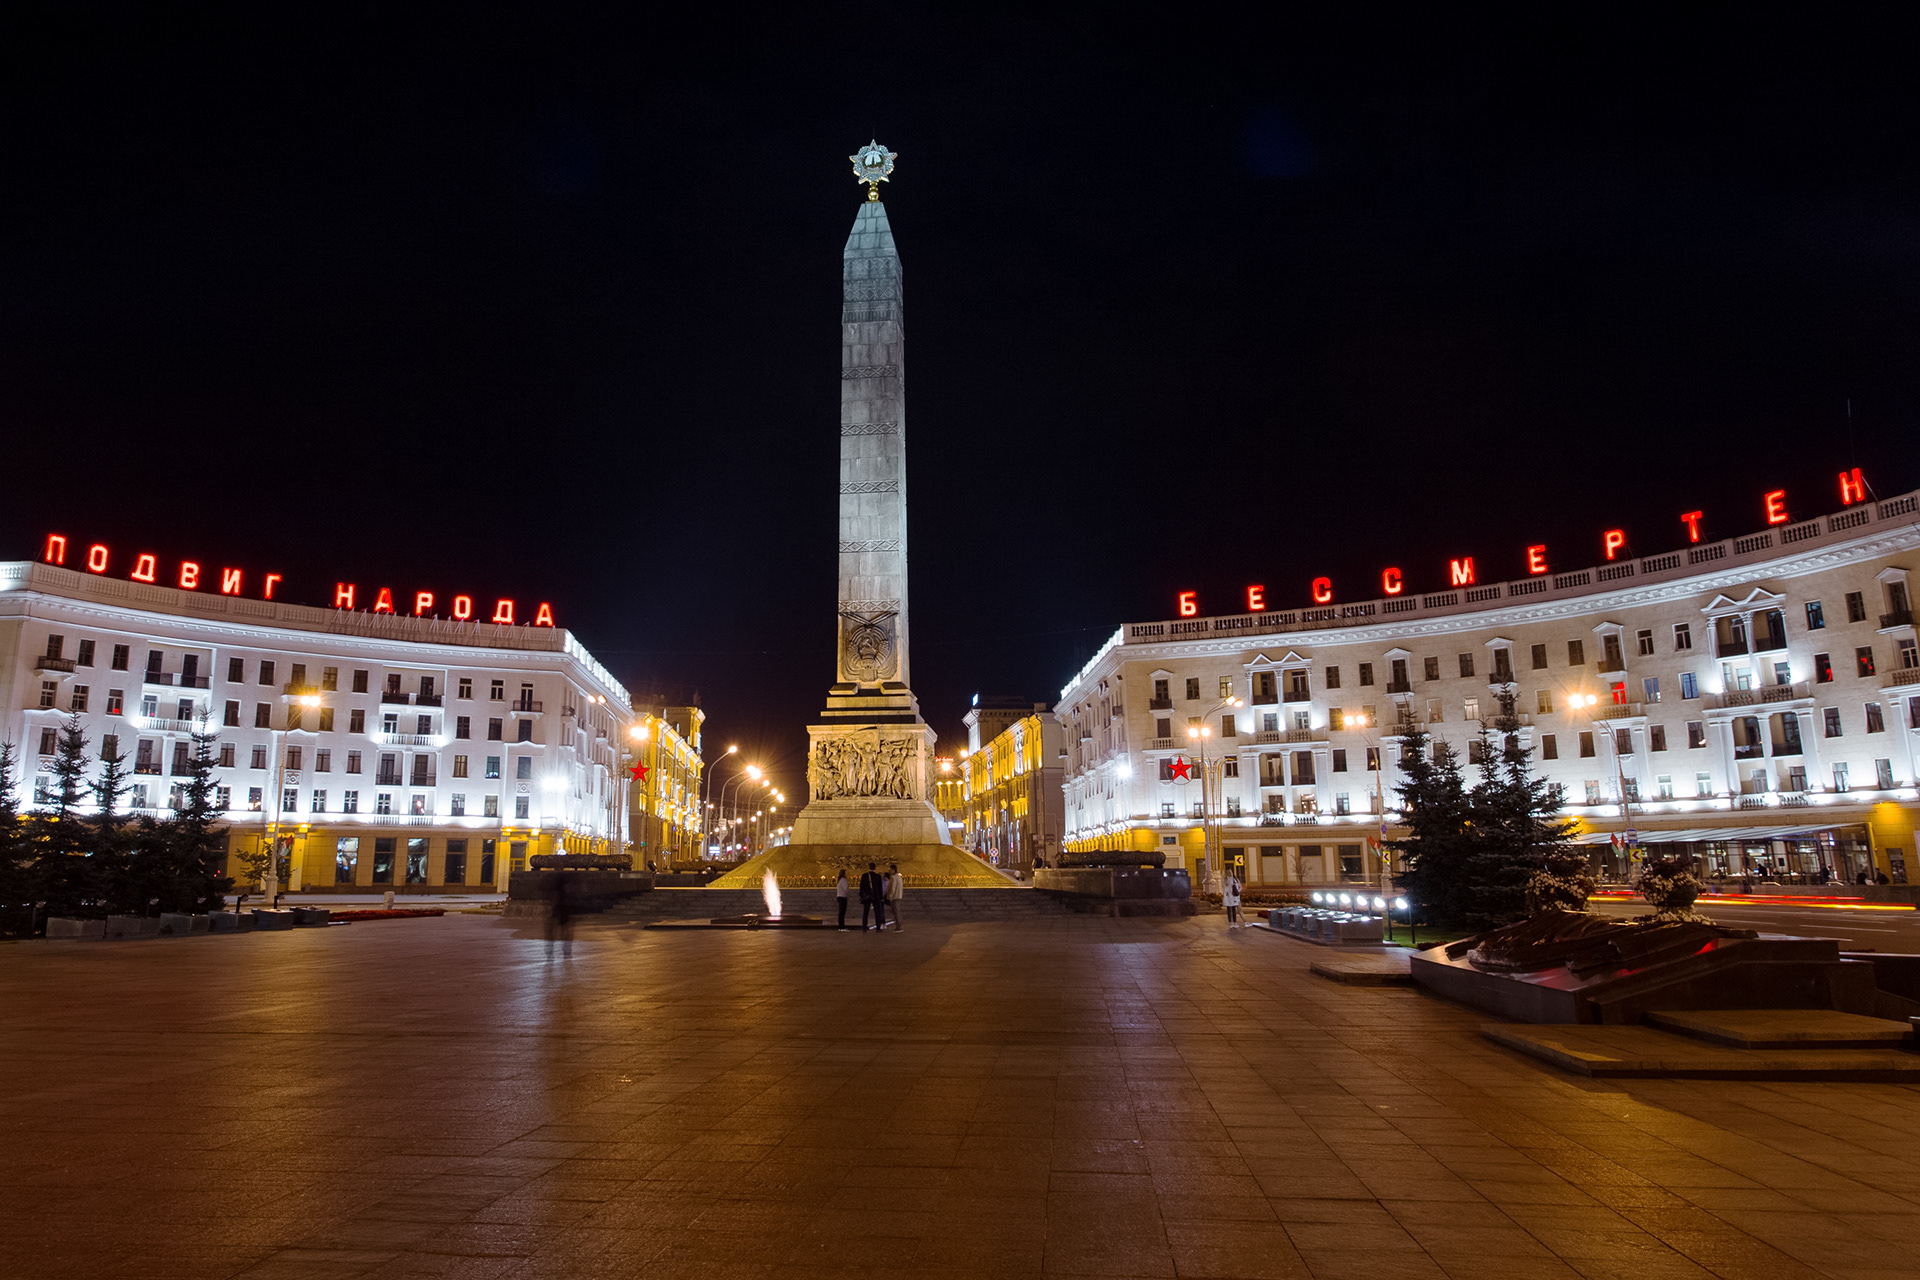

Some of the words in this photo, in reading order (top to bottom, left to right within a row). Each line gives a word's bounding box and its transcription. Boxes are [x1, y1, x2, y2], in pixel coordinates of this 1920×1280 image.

[45, 533, 282, 600] ПОДВИГ
[335, 582, 555, 628] НАРОДА
[1179, 468, 1865, 617] БЕССМЕРТЕН
